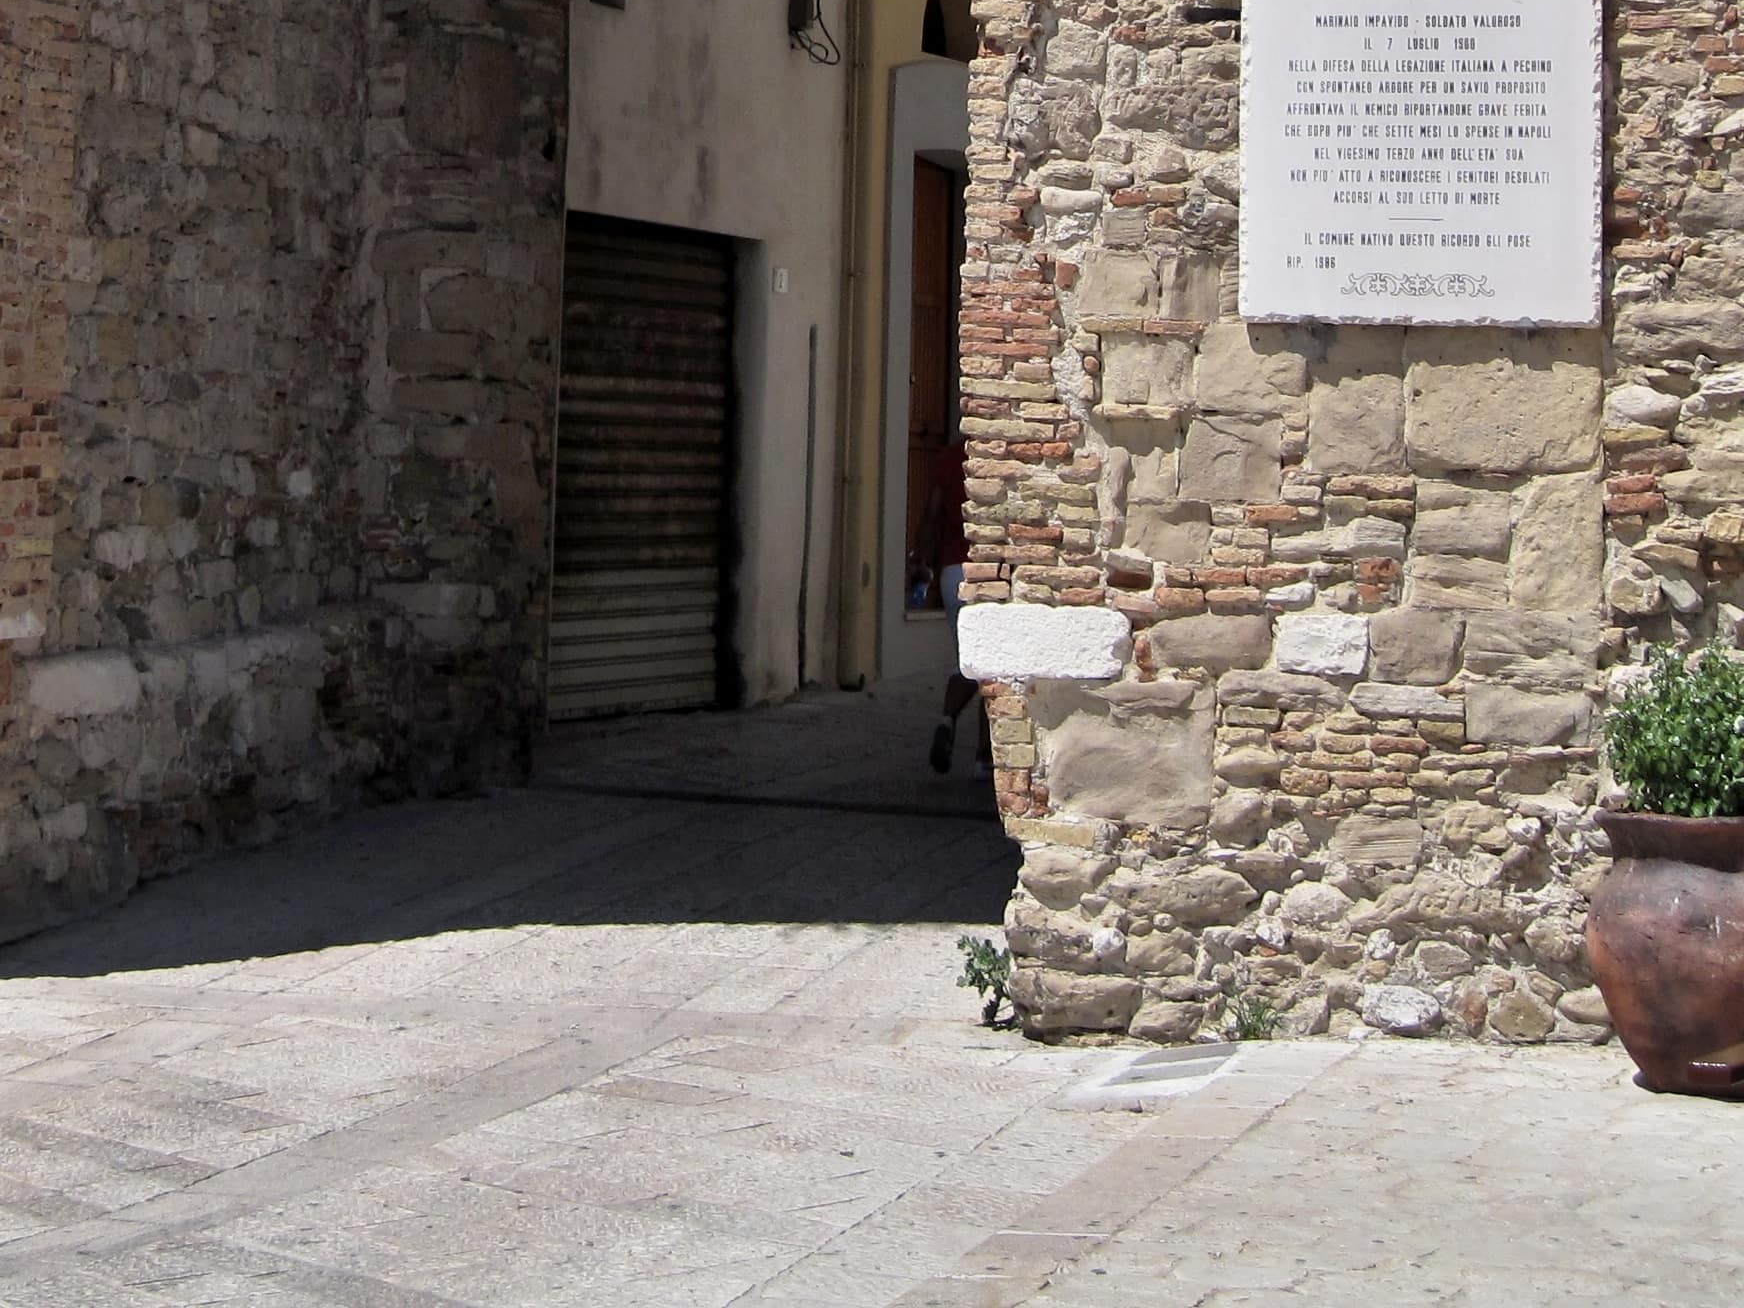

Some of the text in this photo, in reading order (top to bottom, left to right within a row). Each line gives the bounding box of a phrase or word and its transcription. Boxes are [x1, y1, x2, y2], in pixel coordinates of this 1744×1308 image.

[1315, 15, 1358, 28] MARINAIO
[1365, 15, 1409, 28] IMPAVIDO
[1425, 15, 1467, 28] SOLDATO
[1473, 15, 1521, 28] VALOROSO
[1364, 38, 1372, 50] IL
[1407, 38, 1439, 50] LUGLIO
[1455, 38, 1476, 50] 1900
[1289, 60, 1317, 73] NELLA
[1323, 60, 1355, 73] DIFESA
[1361, 60, 1389, 73] DELLA
[1395, 60, 1445, 73] LEGAZIONE
[1451, 60, 1494, 73] ITALIANA
[1513, 60, 1552, 73] PECHINO
[1297, 81, 1546, 94] CON SPONTANEO ARDORE PER UN SAVIO PROPOSITO
[1287, 103, 1547, 116] AFFRONTAVA IL NEMICO RIPORTANDONE GRAVE FERITA
[1285, 125, 1301, 138] CHE
[1308, 125, 1330, 138] DOPO
[1362, 125, 1379, 138] CHE
[1385, 125, 1414, 138] SETTE
[1420, 125, 1441, 138] MESI
[1448, 125, 1458, 138] LO
[1465, 125, 1499, 138] SPENSE
[1505, 125, 1513, 138] IN
[1518, 125, 1551, 138] NAPOLI
[1314, 148, 1330, 161] NEL
[1387, 148, 1415, 161] TERZO
[1421, 148, 1444, 161] ANNO
[1506, 148, 1524, 161] SUA
[1290, 170, 1307, 183] NON
[1339, 170, 1361, 183] ATTO
[1380, 170, 1441, 183] RICONOSCERE
[1457, 170, 1499, 183] GENITORI
[1505, 170, 1550, 183] DESOLATI
[1333, 192, 1500, 204] ACCORSI AL SUO LETTO DI MORTE
[1305, 233, 1531, 247] IL COMUNE NATIVO QUESTO RICORDO GLI POSE
[1315, 256, 1336, 269] 1986
